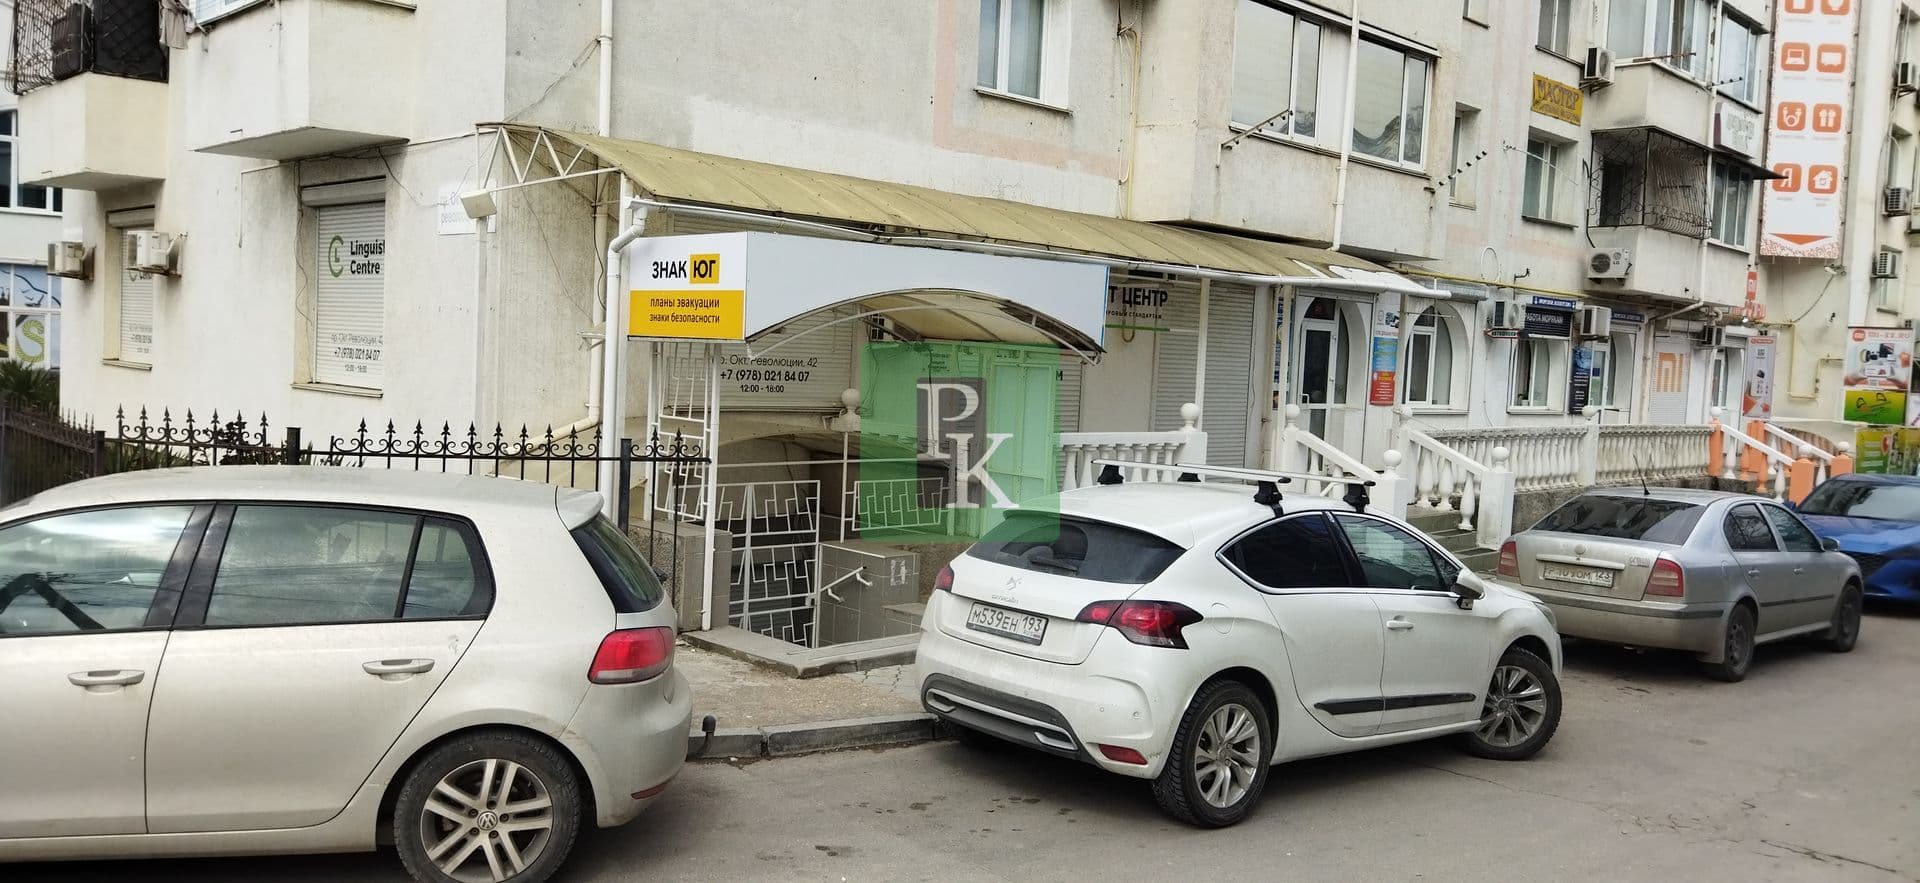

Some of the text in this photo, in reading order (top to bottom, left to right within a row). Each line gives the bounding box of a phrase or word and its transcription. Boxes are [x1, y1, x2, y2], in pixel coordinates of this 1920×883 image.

[350, 260, 381, 275] Centre
[652, 259, 717, 279] ЗНАК ЮГ
[650, 298, 720, 310] планы эвакуации
[1121, 287, 1168, 308] ЦЕНТР
[649, 312, 720, 324] знаки безопасности
[807, 357, 818, 368] 42
[720, 369, 810, 382] +7 (978) 021 84 07
[740, 384, 760, 393] 12:00
[766, 384, 785, 393] 18:00
[1022, 615, 1043, 632] 193
